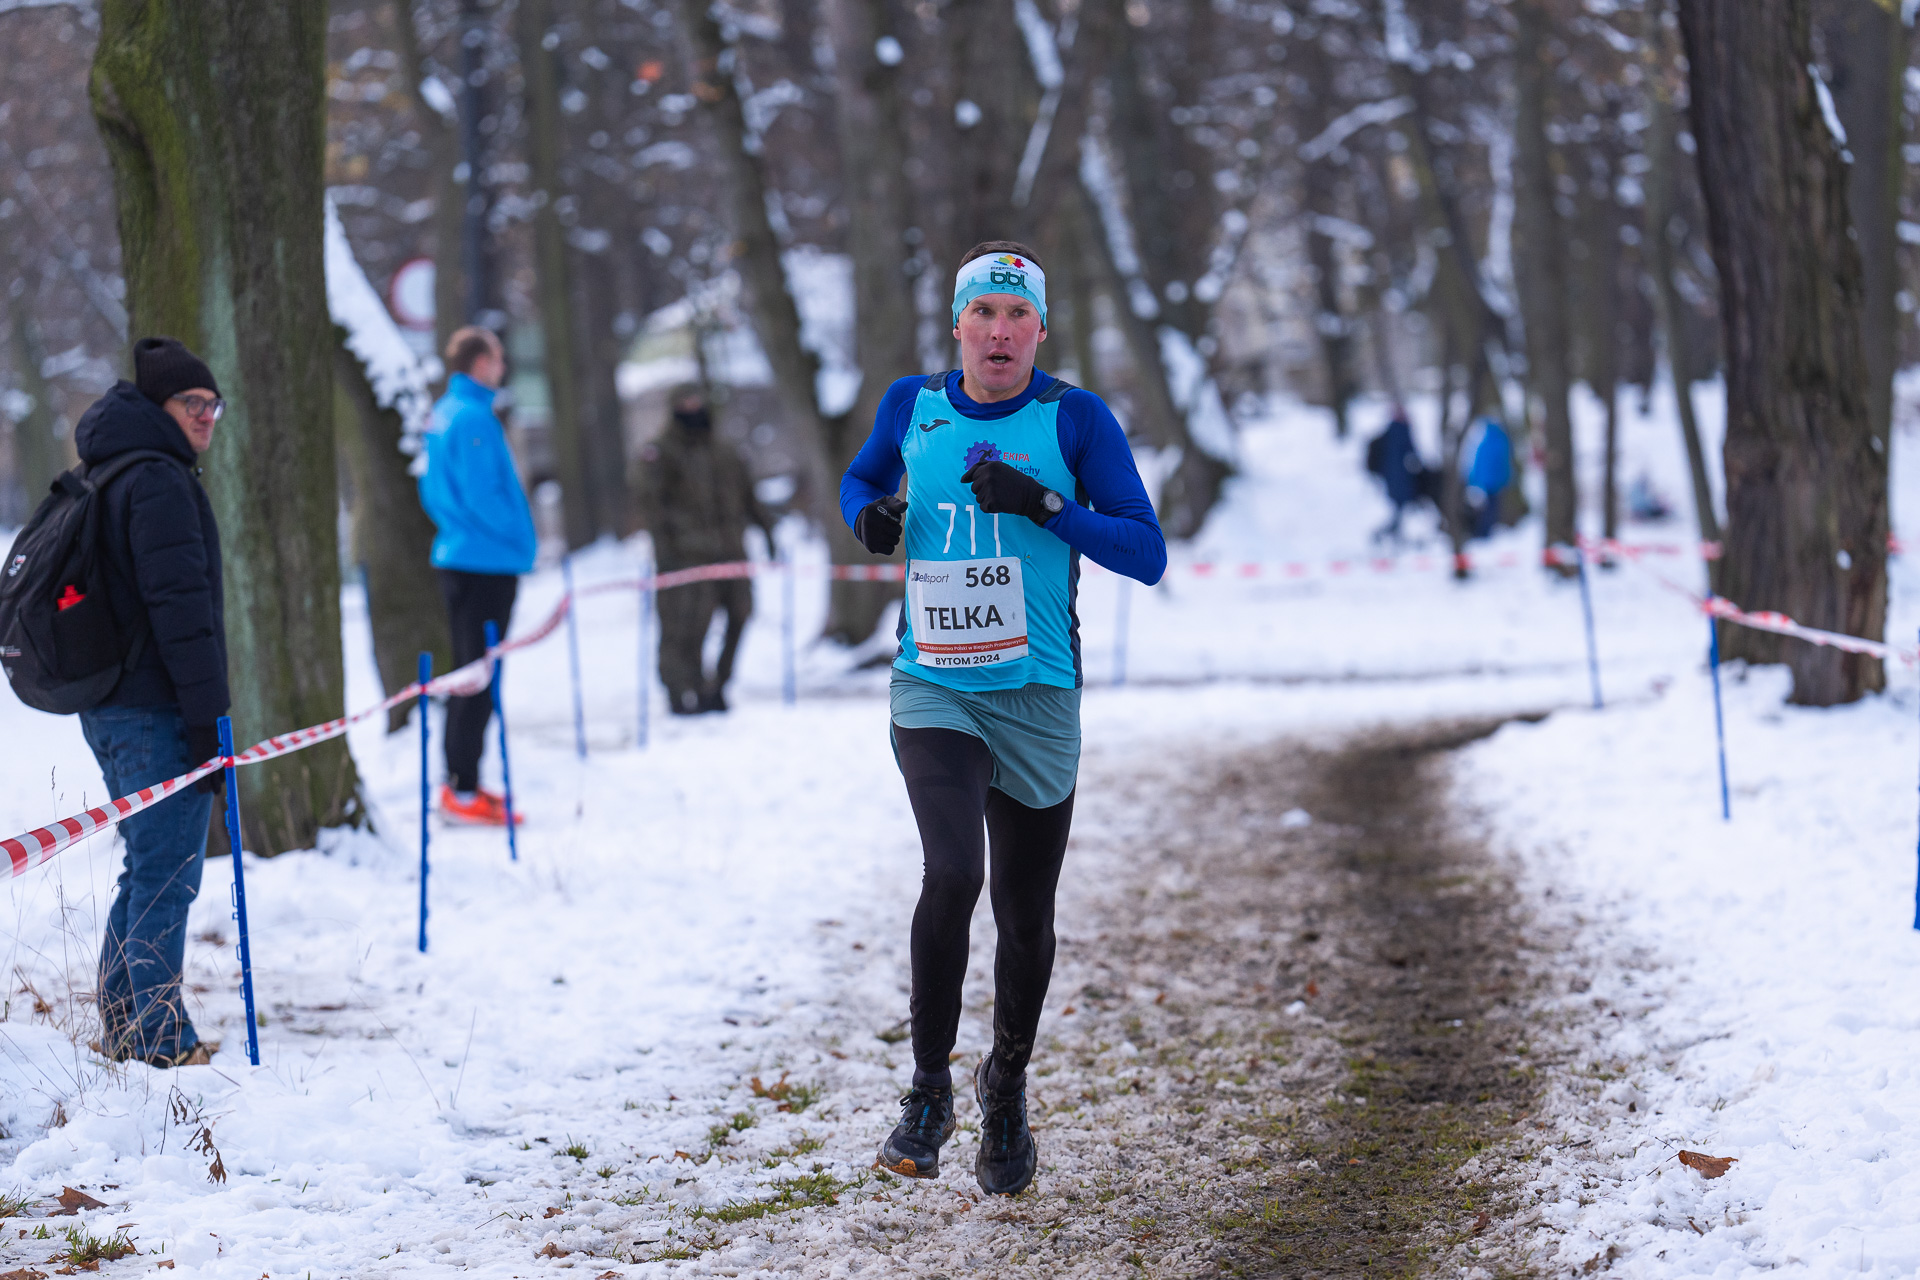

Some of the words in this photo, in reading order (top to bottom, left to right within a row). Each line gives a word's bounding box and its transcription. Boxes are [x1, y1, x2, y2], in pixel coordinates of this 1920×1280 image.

[1002, 451, 1030, 462] EKIPA
[1015, 464, 1041, 477] lachy
[965, 564, 1011, 588] 568
[924, 604, 1004, 630] TELKA
[973, 643, 993, 651] Biegach
[935, 657, 971, 666] BYTOM
[973, 653, 1000, 664] 2024
